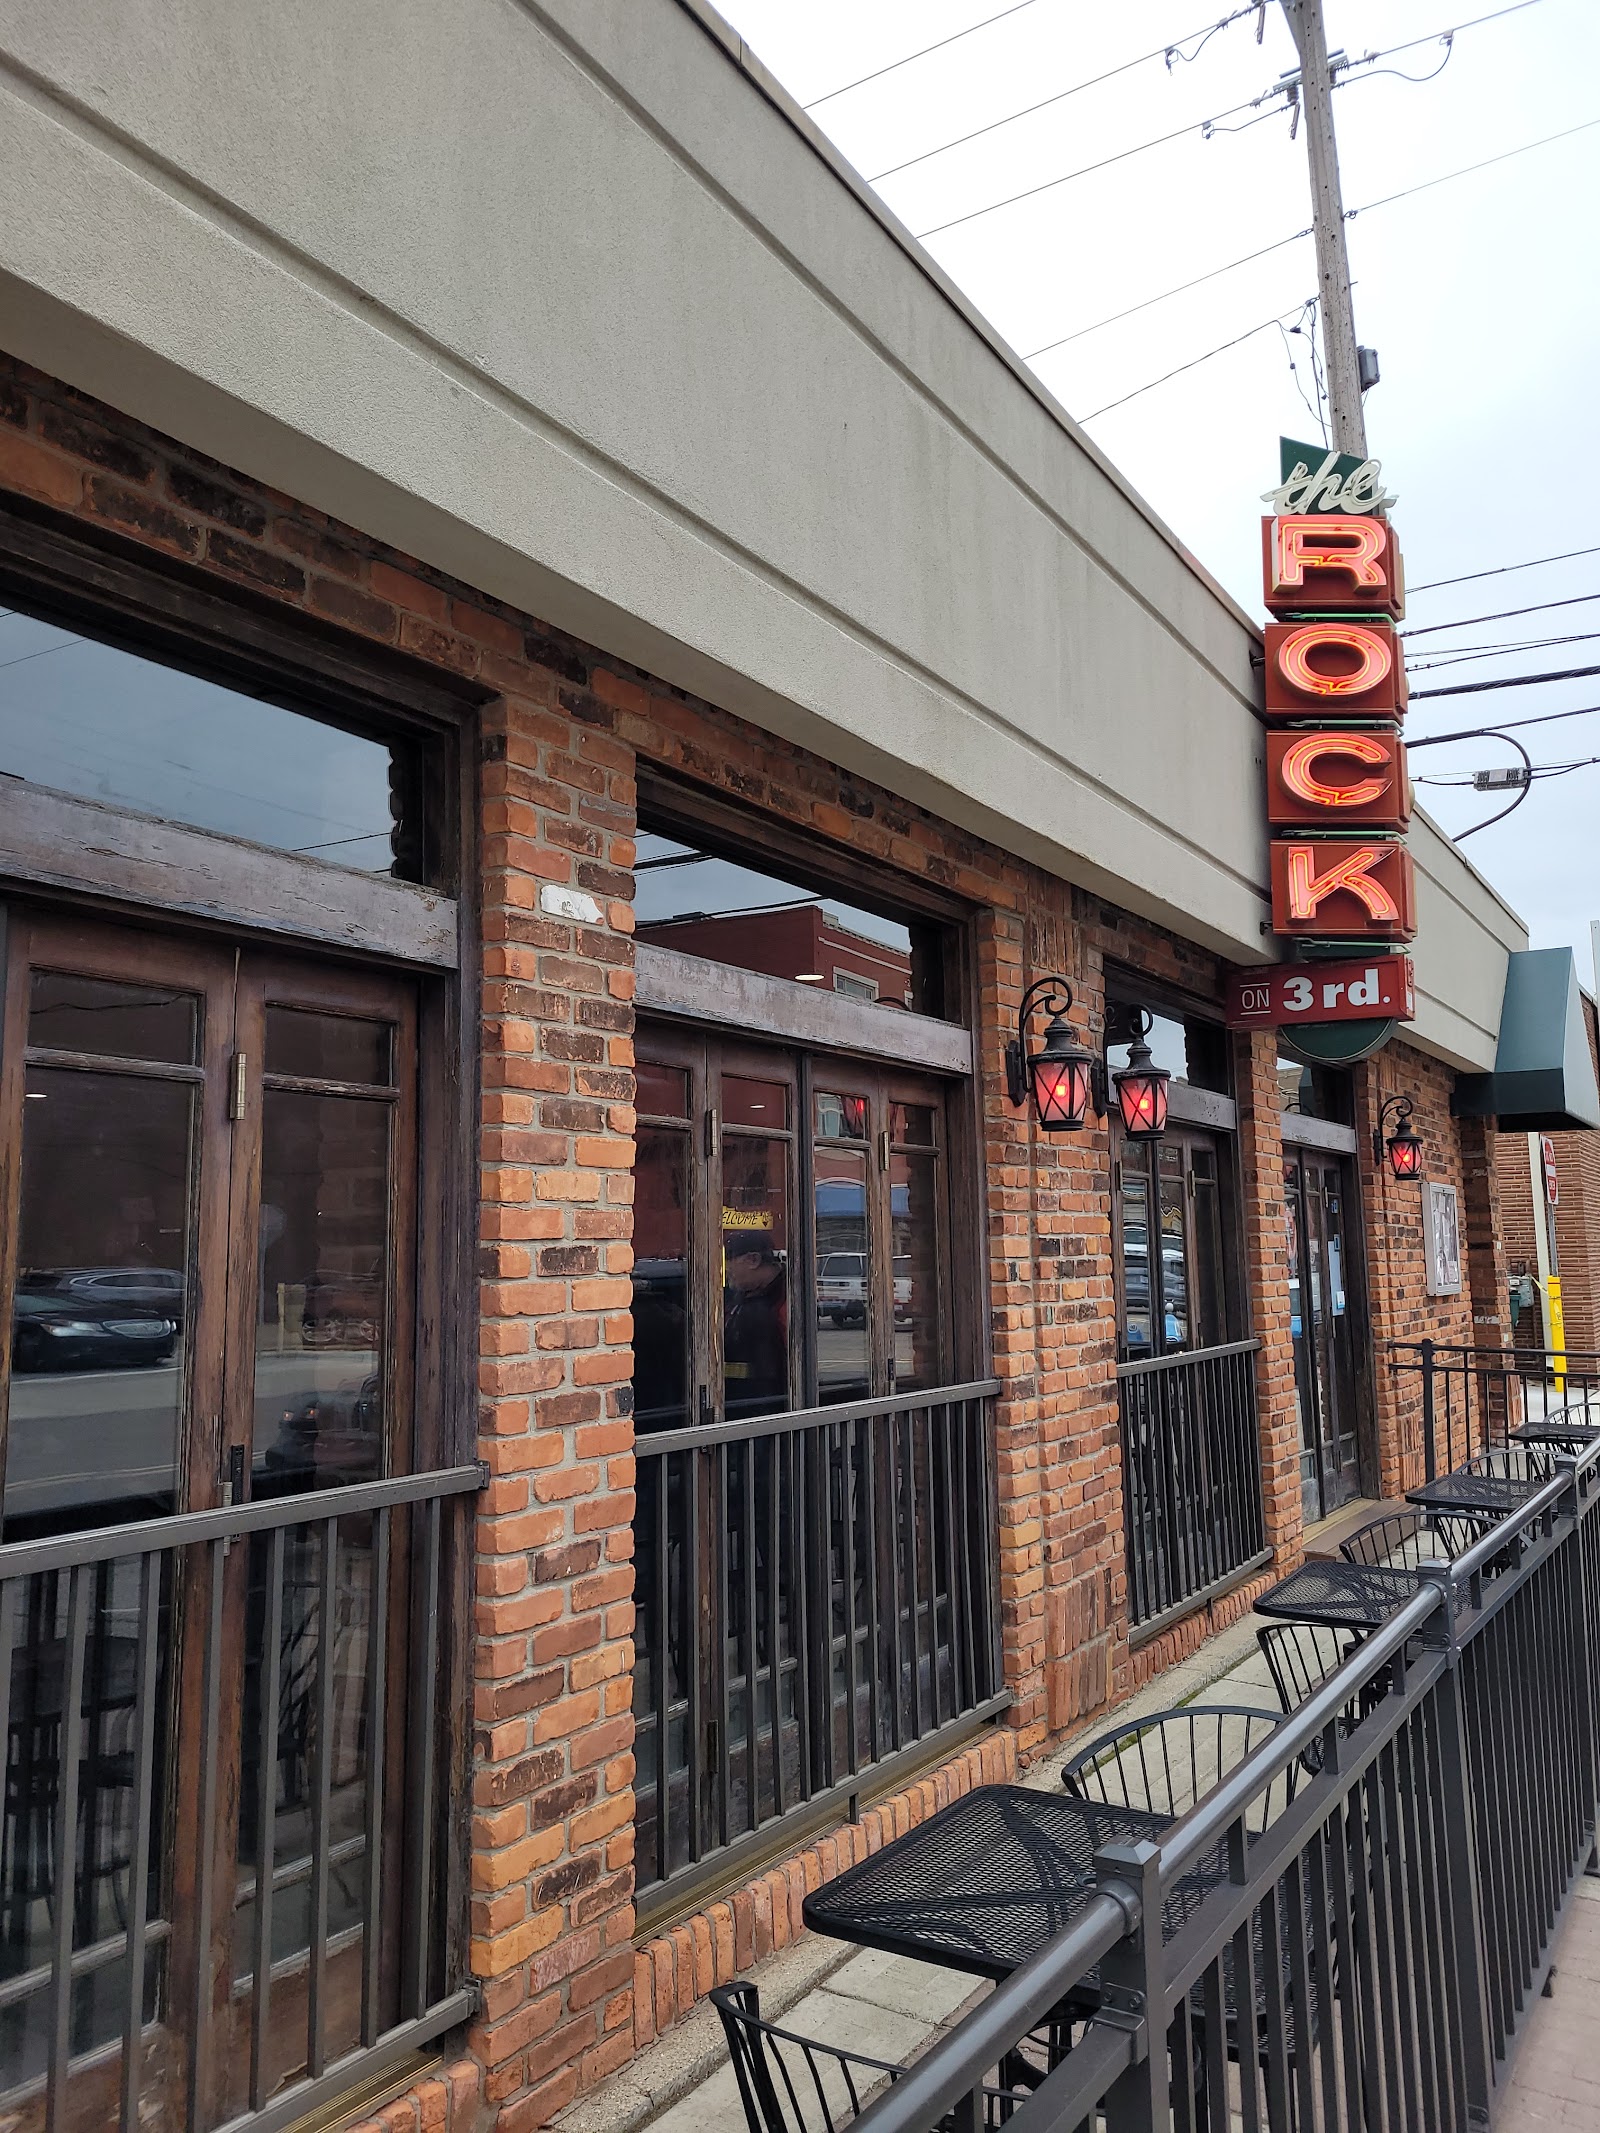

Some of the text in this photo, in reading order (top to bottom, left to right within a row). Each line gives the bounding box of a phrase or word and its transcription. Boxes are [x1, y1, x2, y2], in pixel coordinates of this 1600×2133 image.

[1260, 450, 1388, 515] the
[1273, 515, 1399, 921] ROCK
[1241, 968, 1391, 1012] ON 3rd.
[722, 1210, 758, 1226] ELCOME
